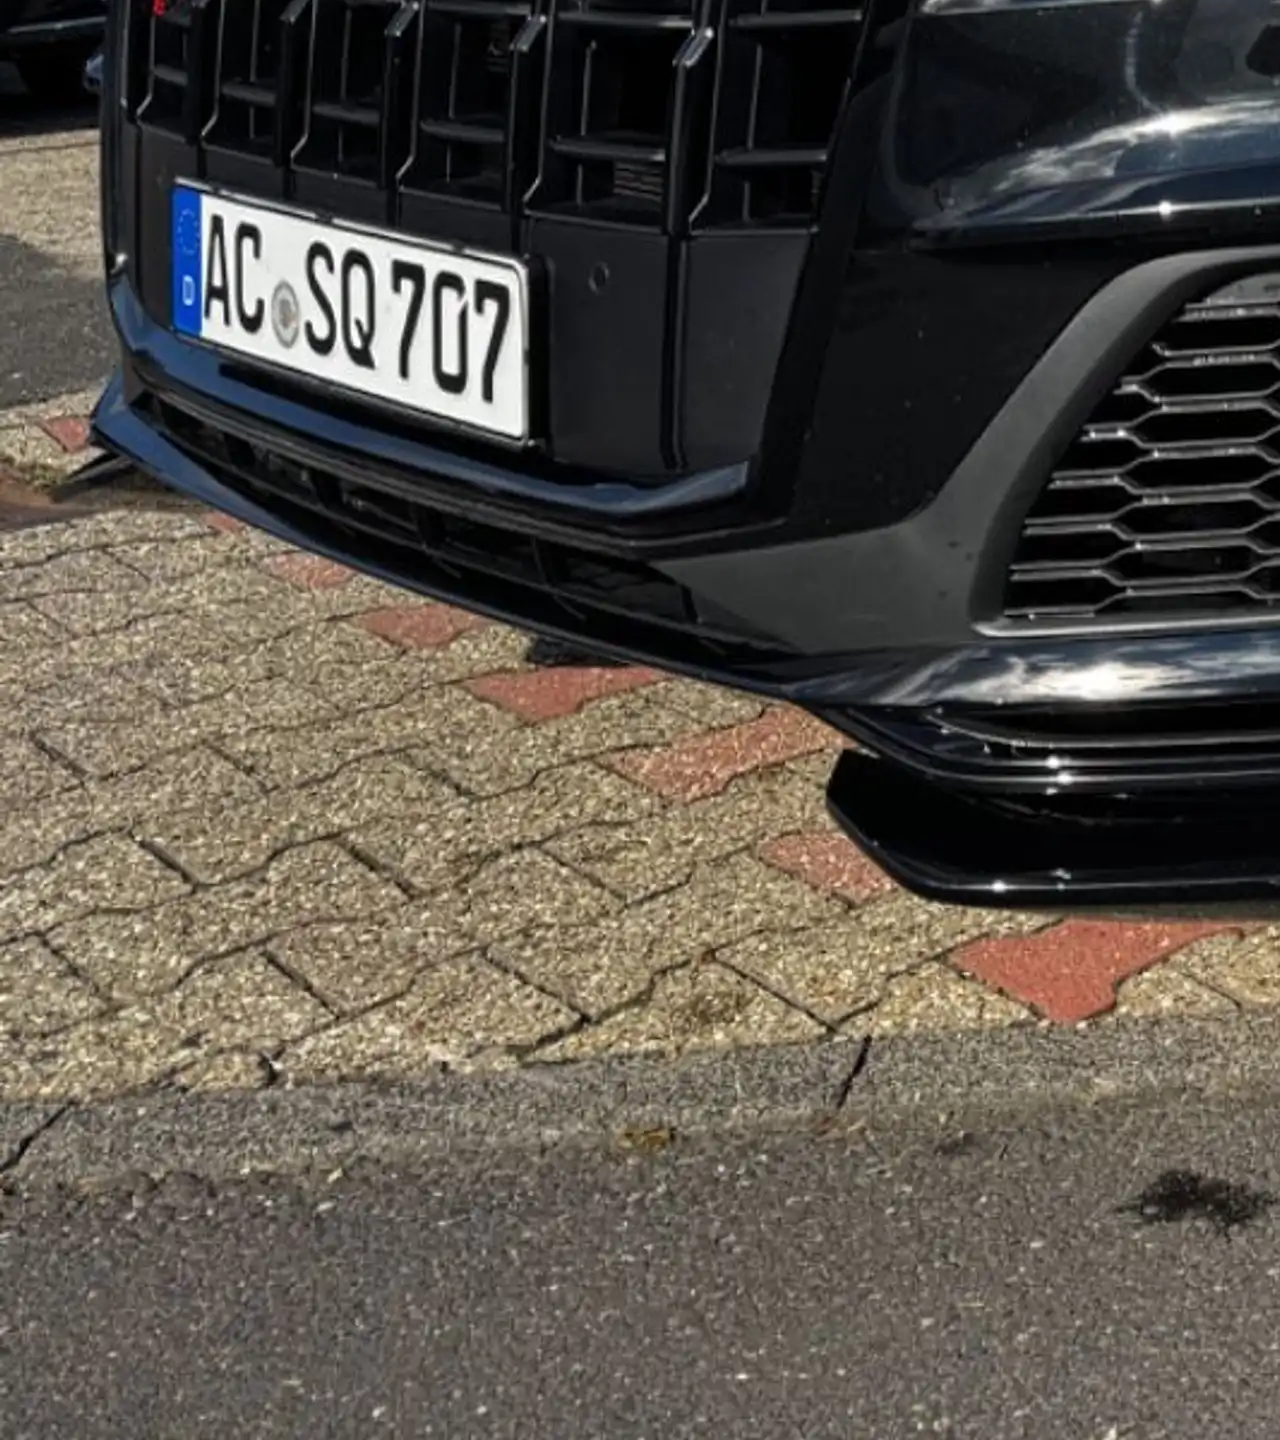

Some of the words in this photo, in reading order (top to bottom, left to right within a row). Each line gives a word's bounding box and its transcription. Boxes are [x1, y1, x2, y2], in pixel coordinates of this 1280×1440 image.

[203, 214, 265, 334] AC
[304, 241, 376, 370] SQ
[391, 260, 511, 403] 707
